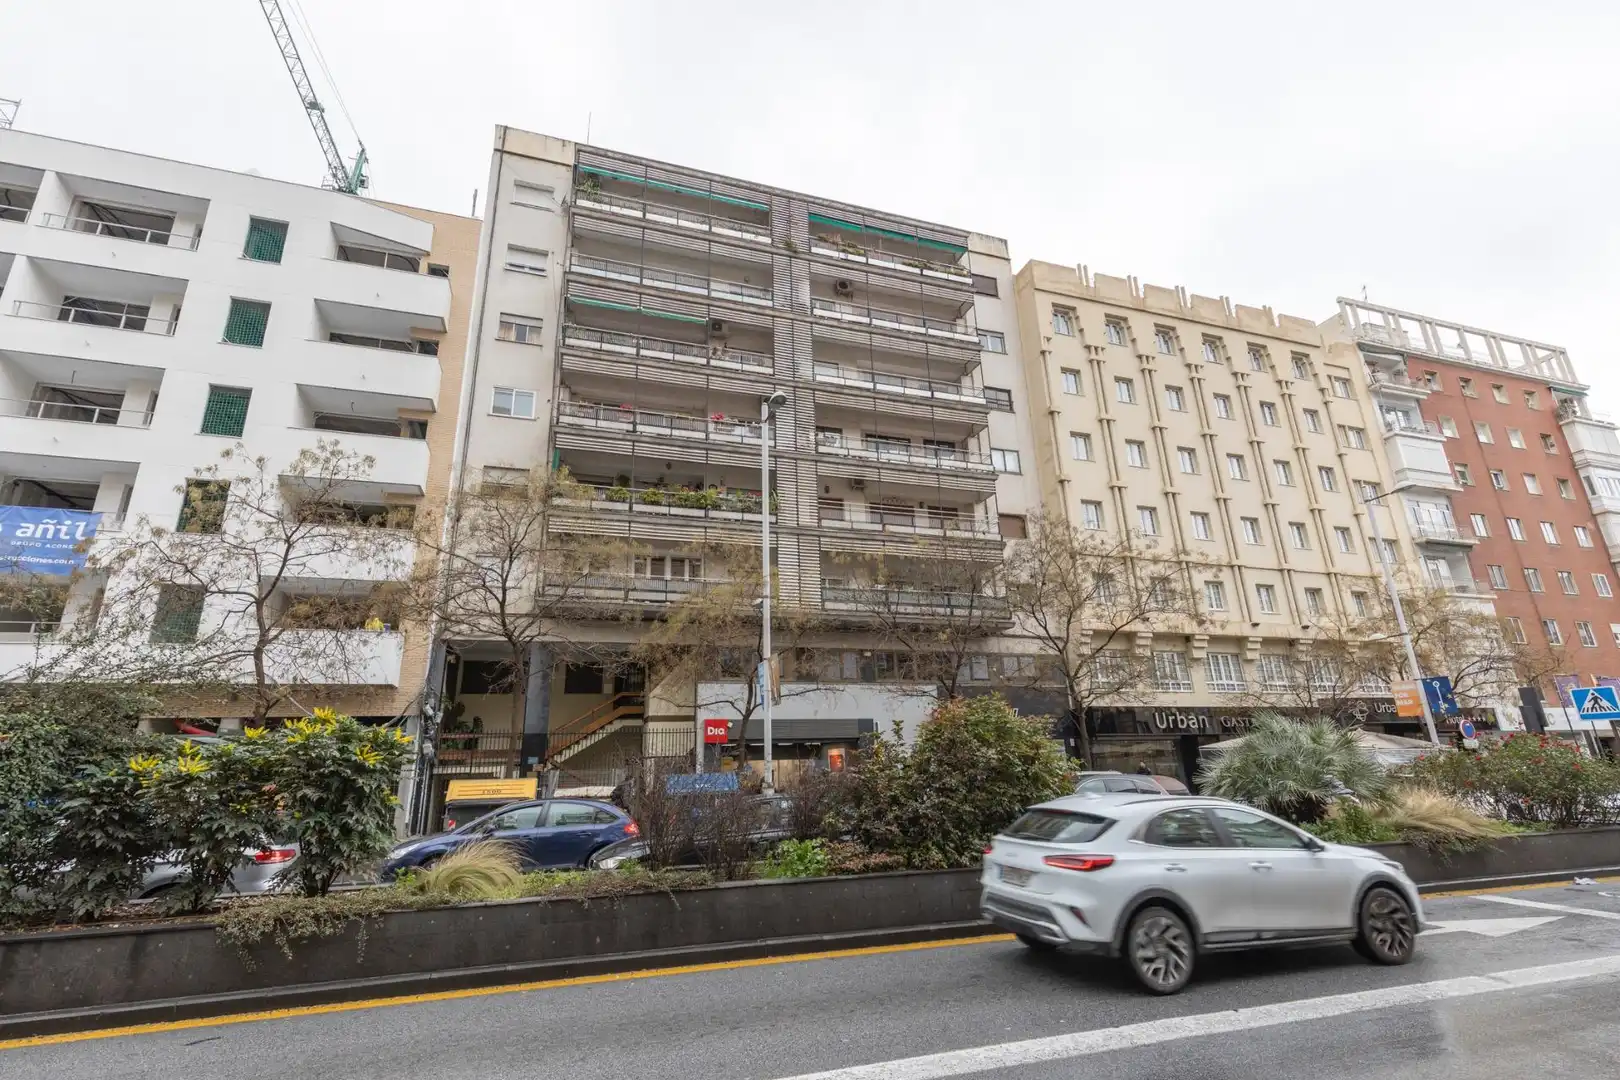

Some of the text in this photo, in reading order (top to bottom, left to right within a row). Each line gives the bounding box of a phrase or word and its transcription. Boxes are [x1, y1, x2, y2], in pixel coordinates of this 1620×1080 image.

[16, 519, 87, 541] añil
[1374, 703, 1397, 713] Urba
[1155, 711, 1252, 729] Urban GAST
